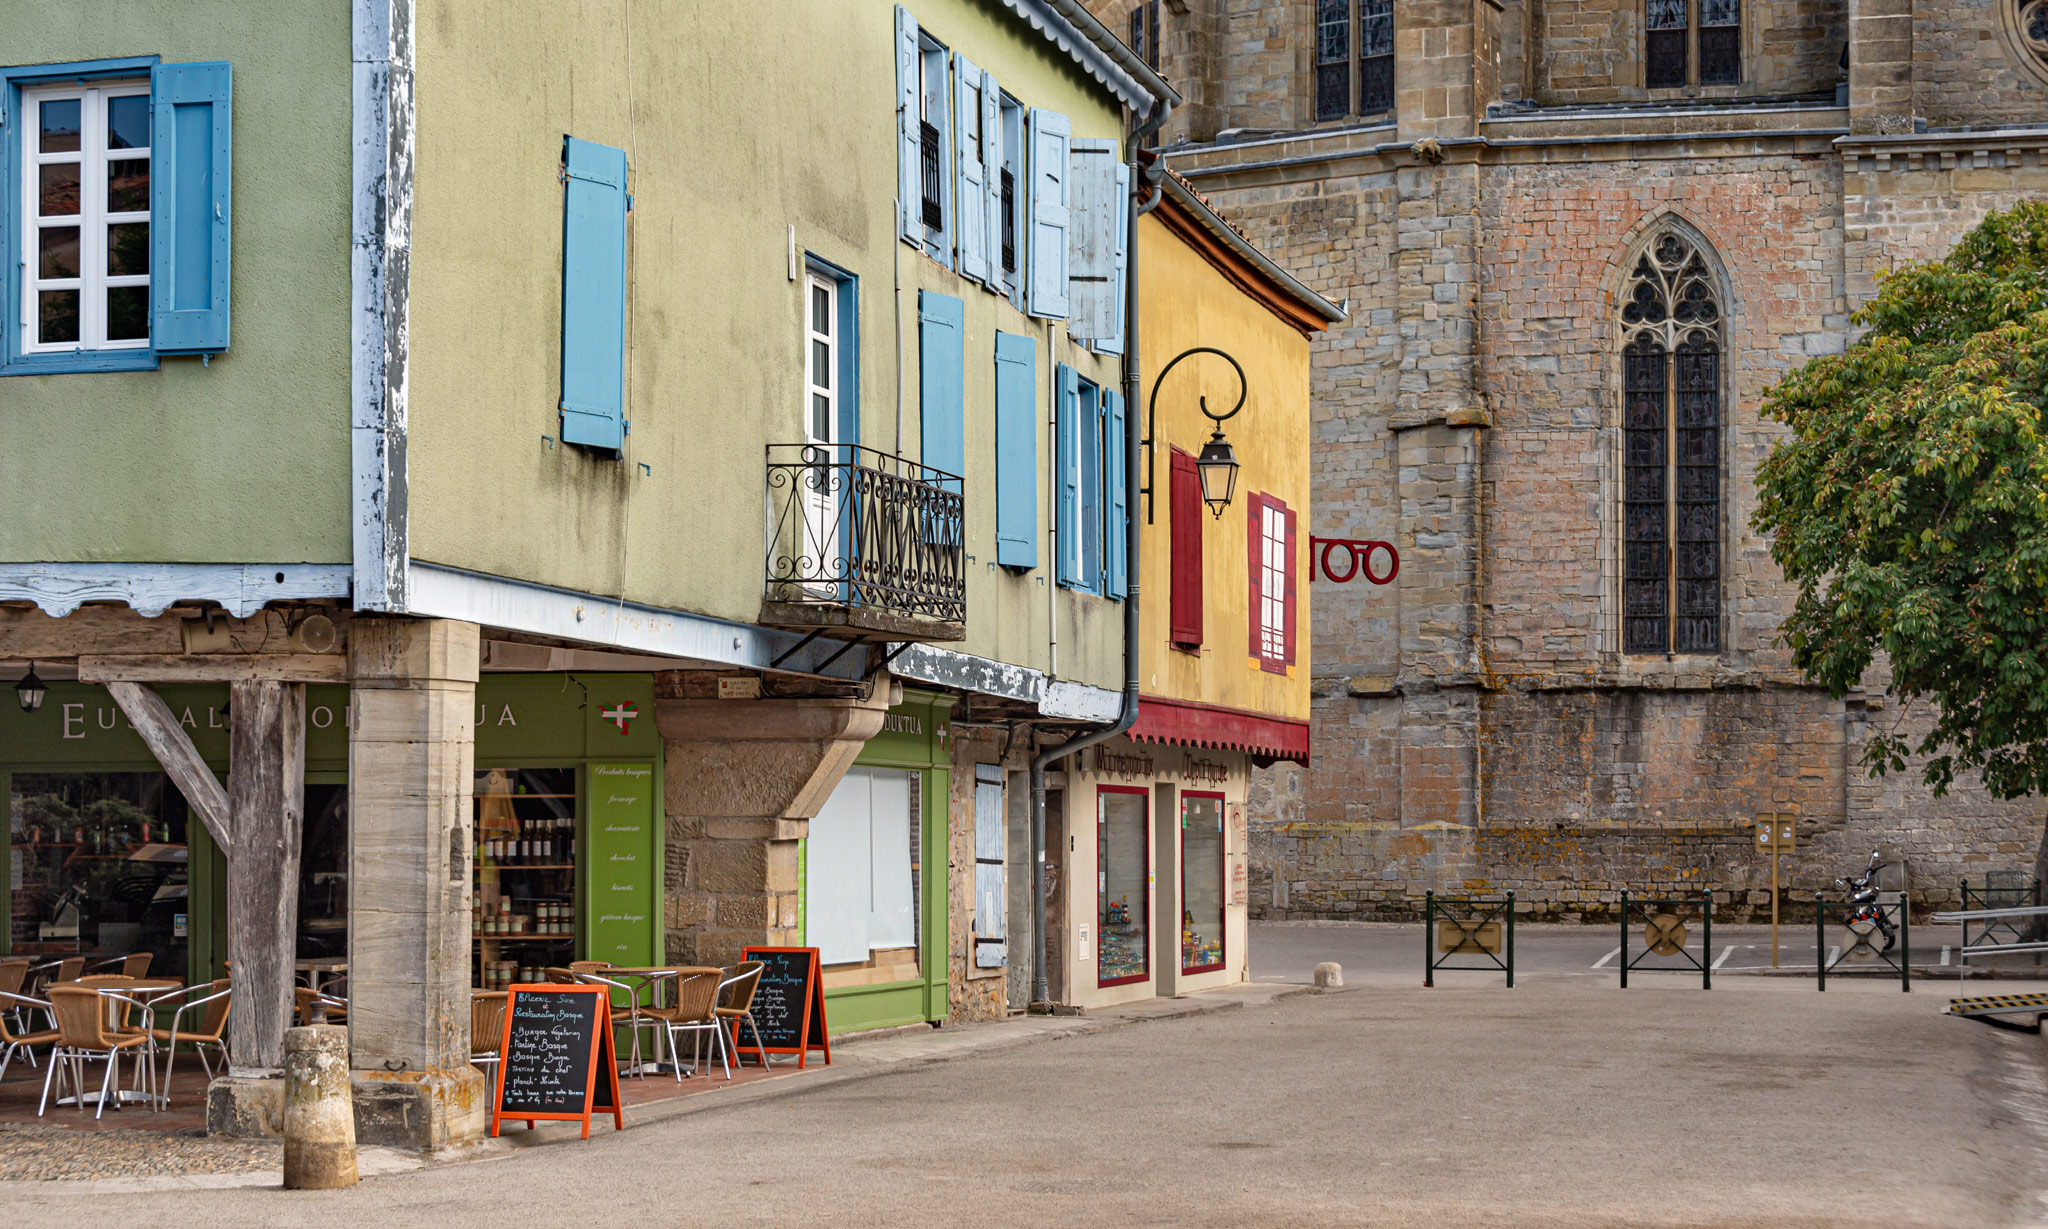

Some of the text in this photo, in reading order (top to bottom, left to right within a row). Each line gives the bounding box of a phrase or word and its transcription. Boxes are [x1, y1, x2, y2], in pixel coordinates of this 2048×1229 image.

[63, 703, 223, 739] EUAL
[884, 713, 922, 735] DUKTUA
[595, 766, 652, 779] Produits basques
[608, 794, 637, 806] fromage
[605, 823, 640, 832] charcuterie
[610, 853, 636, 862] chocolat
[611, 883, 634, 891] biscuits
[623, 912, 644, 924] basque
[556, 1009, 584, 1024] Basque
[538, 1038, 568, 1053] Basque
[512, 1051, 541, 1064] Basque
